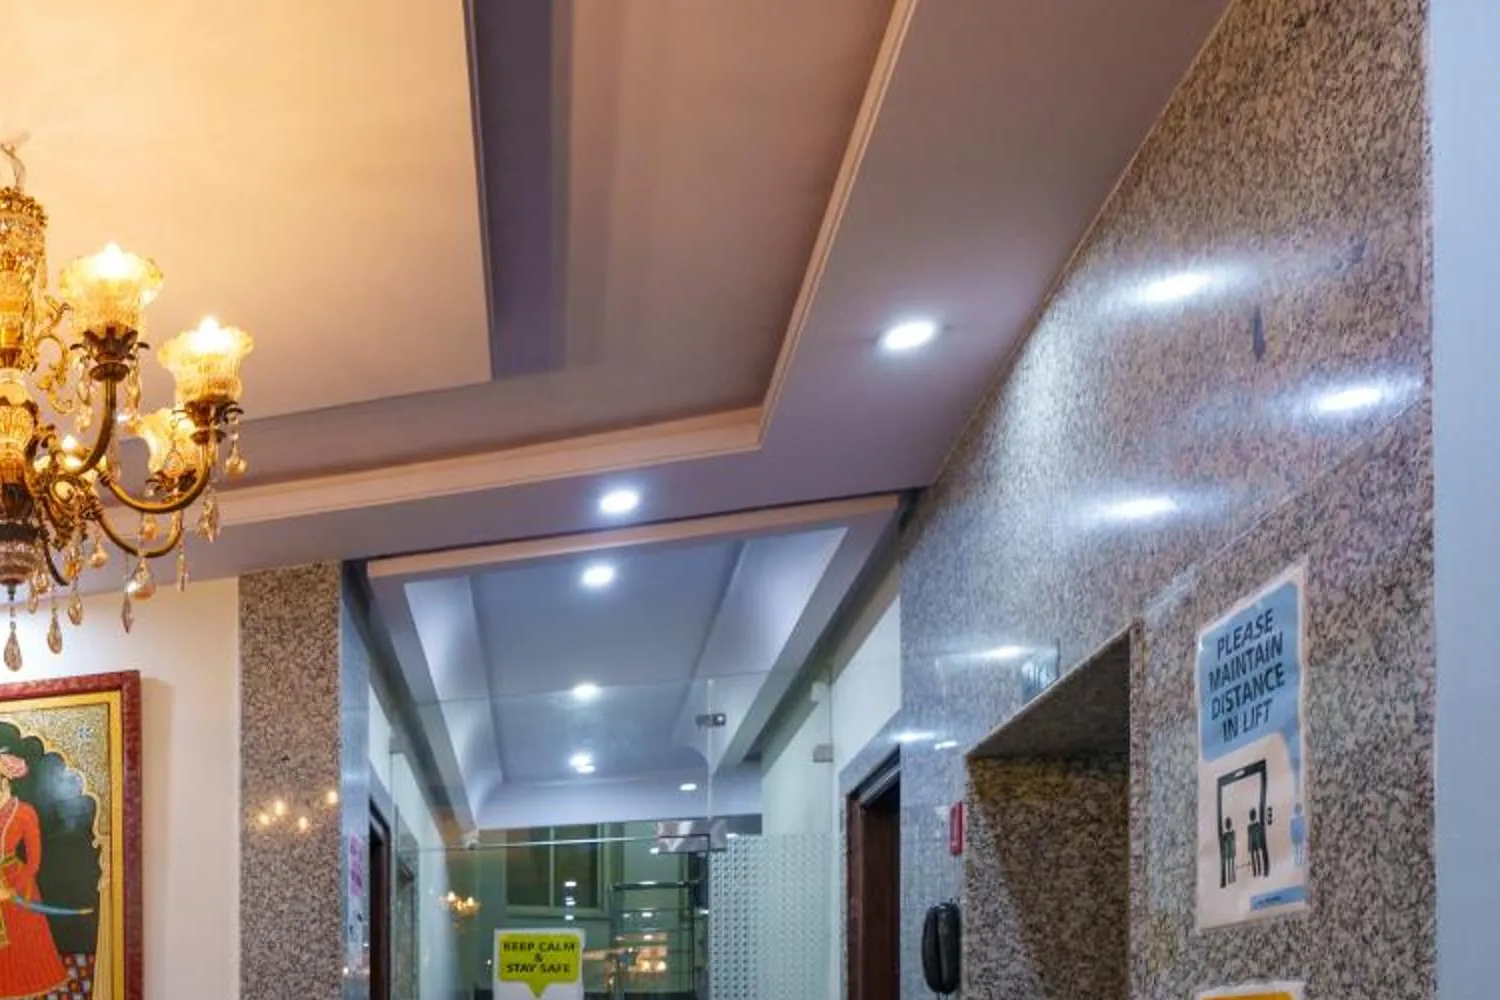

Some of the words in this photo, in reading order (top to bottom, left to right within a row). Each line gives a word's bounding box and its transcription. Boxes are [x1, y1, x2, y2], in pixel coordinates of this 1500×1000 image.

[1217, 608, 1274, 660] PLEASE
[1208, 632, 1283, 693] MAINTAIN
[1211, 662, 1285, 720] DISTANCE
[1222, 715, 1239, 743] IN
[1242, 699, 1273, 733] LIFT
[503, 942, 534, 952] KEEP
[539, 942, 575, 952] CALM
[507, 964, 536, 973] STAY
[541, 964, 570, 973] SAFE
